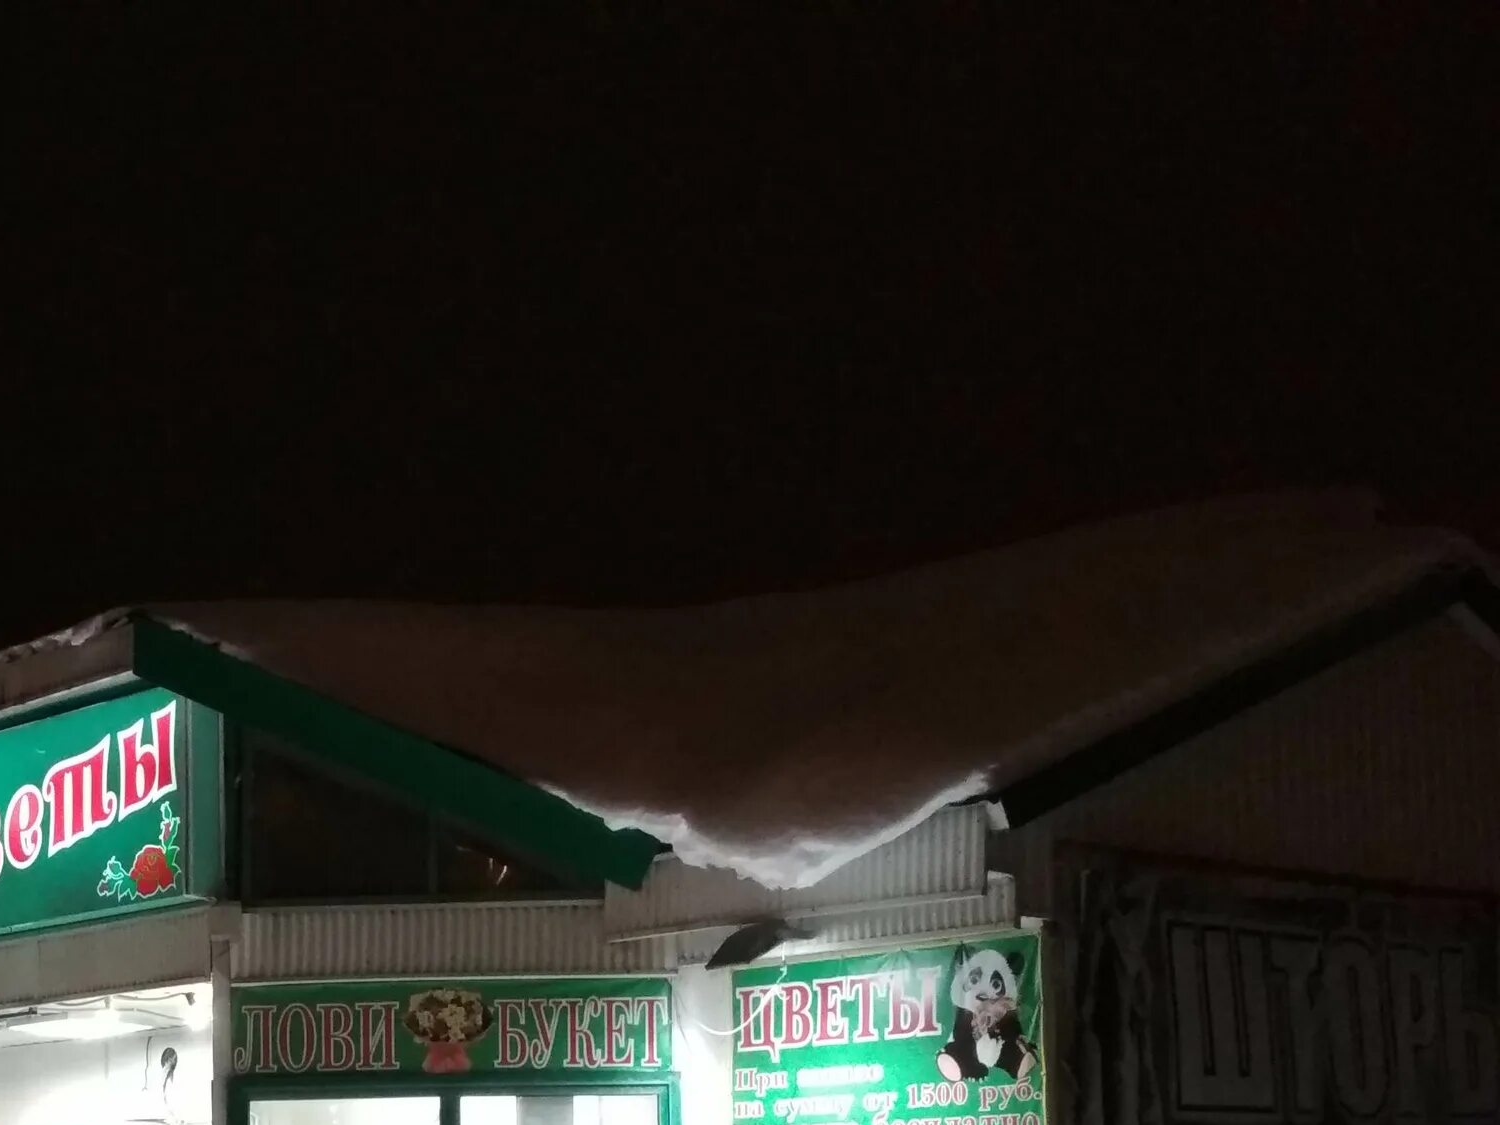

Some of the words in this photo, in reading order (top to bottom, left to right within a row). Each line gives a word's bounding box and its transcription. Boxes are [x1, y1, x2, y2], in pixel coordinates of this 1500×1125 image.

[234, 1001, 400, 1073] ЛОВИ
[494, 996, 669, 1069] БУКЕТ
[736, 966, 943, 1063] ЦВЕТЫ
[735, 1068, 788, 1098] При
[735, 1098, 764, 1120] на
[862, 1091, 898, 1112] от
[906, 1082, 968, 1109] 1500
[978, 1076, 1043, 1112] руб.
